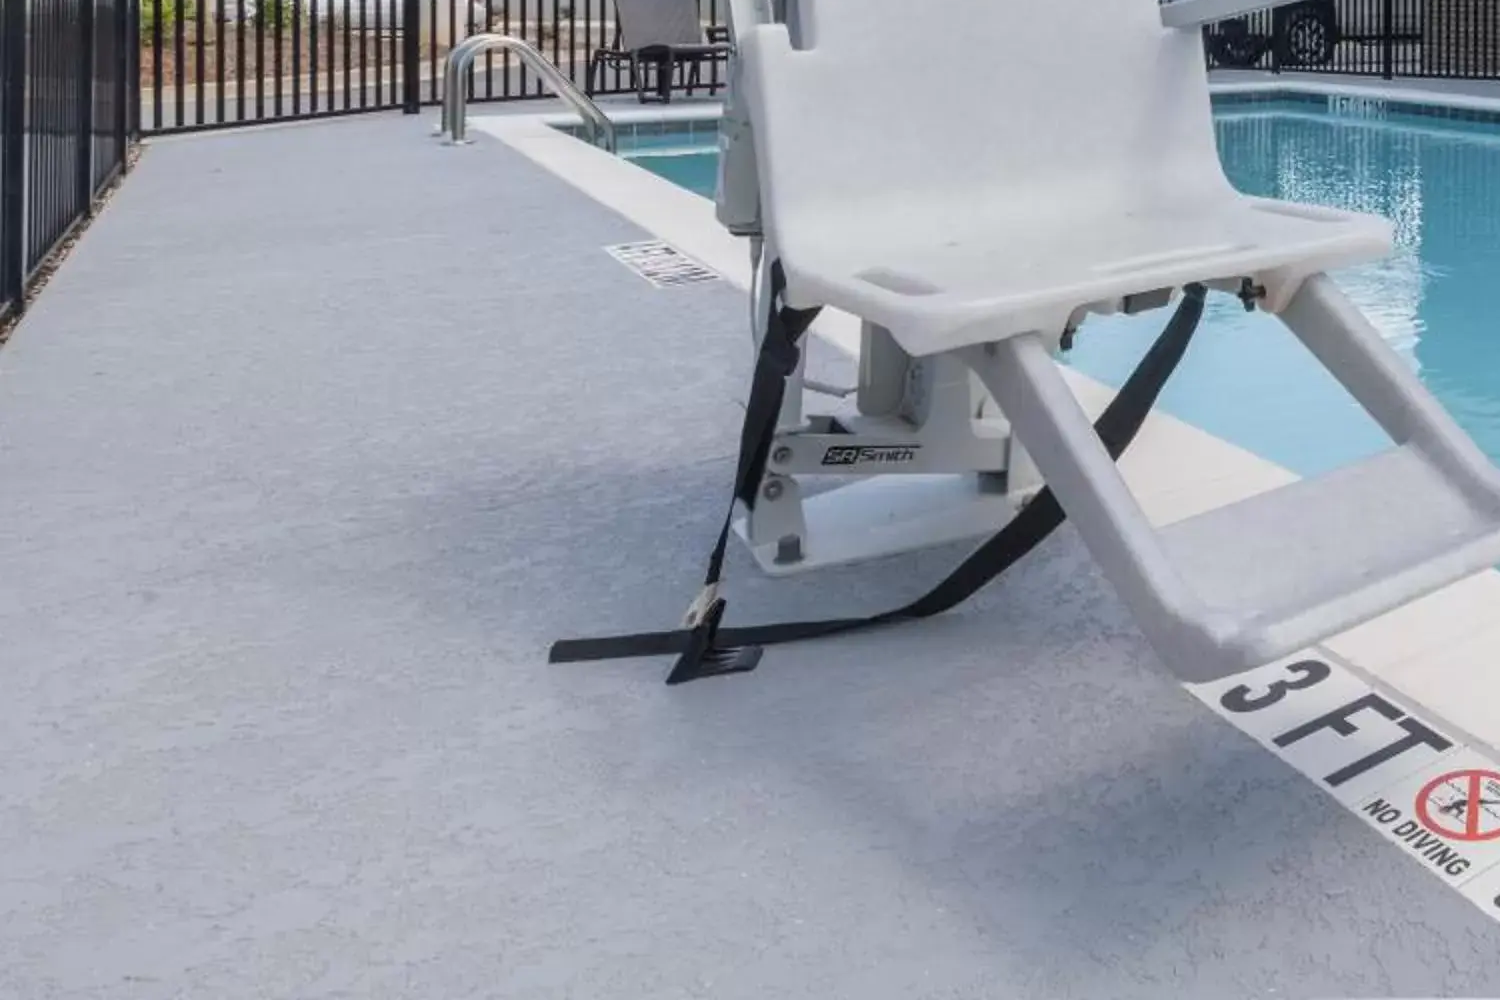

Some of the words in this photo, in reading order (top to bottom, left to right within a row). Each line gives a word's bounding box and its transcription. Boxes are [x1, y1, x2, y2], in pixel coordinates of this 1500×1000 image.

[1220, 659, 1331, 713] 3
[1272, 692, 1454, 788] FT
[1363, 799, 1400, 825] NO
[1392, 820, 1471, 877] DIVING
